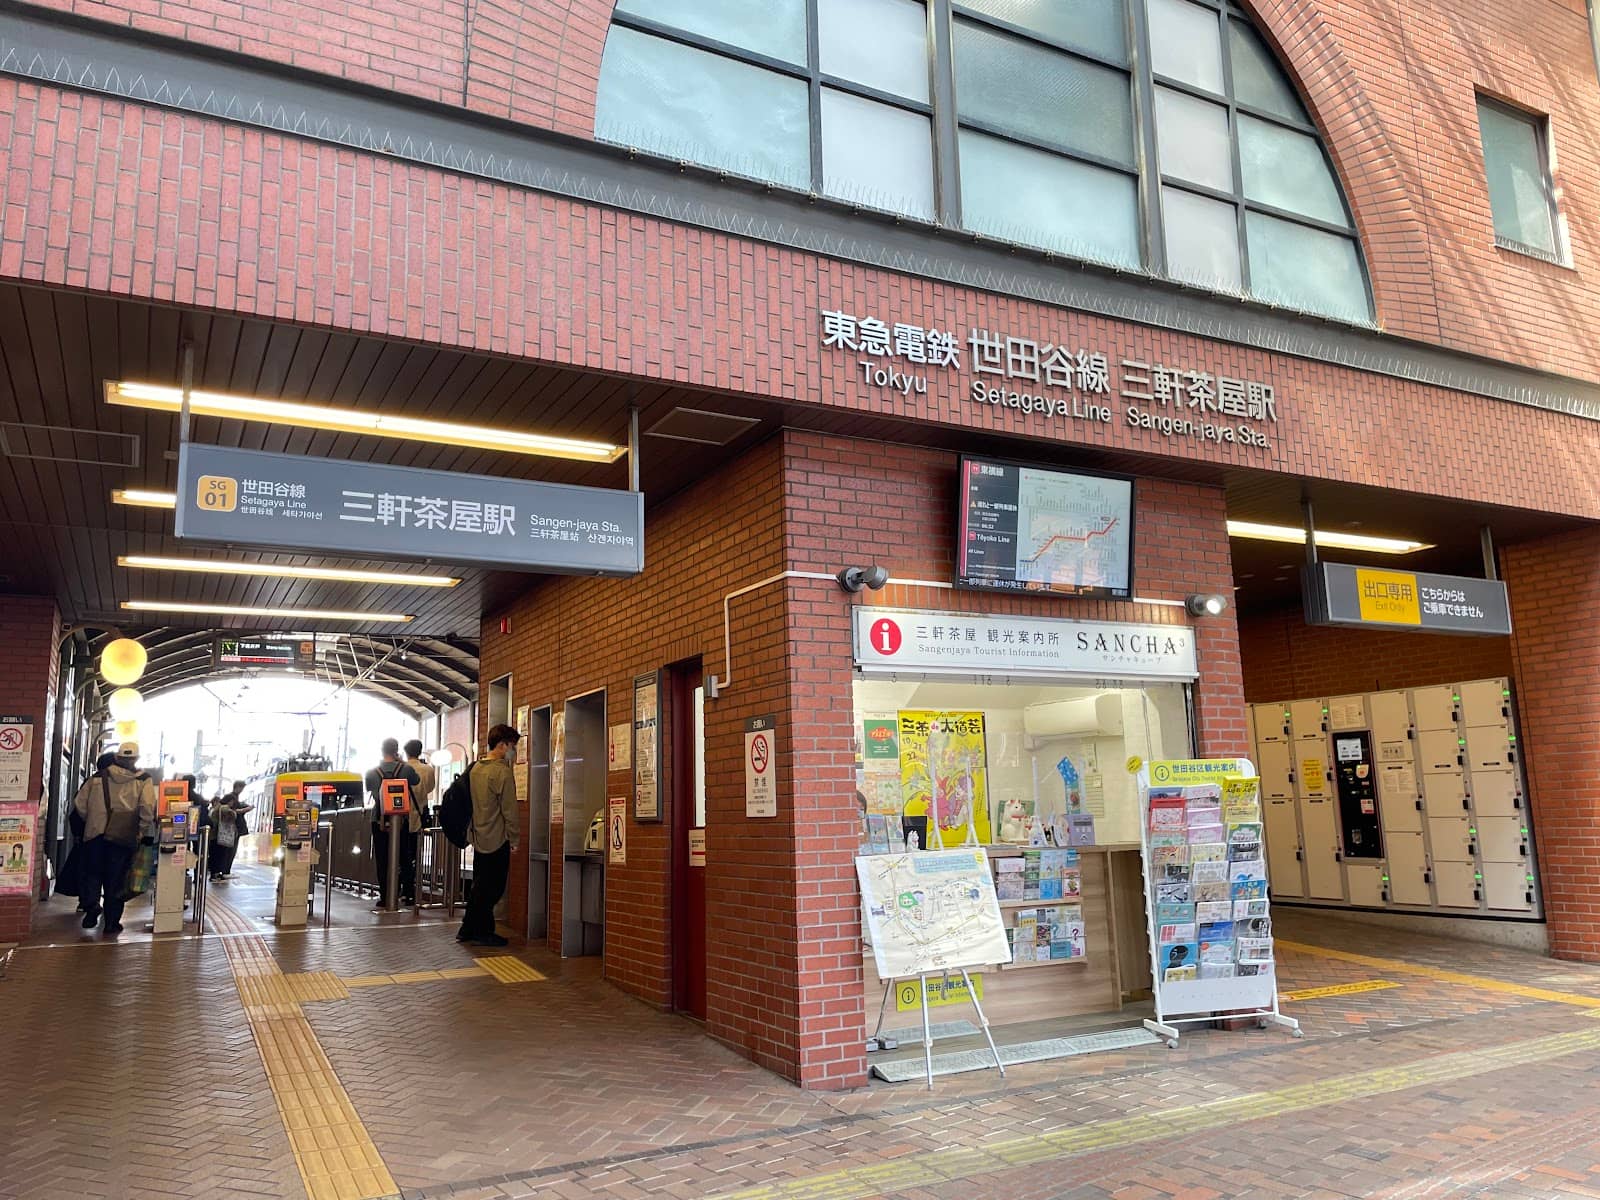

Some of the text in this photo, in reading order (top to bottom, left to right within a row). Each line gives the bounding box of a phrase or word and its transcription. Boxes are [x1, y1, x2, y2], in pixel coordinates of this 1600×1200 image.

[822, 310, 1278, 423] 東急電鉄 世田谷線 三軒茶屋駅
[859, 361, 1273, 449] Tokyu Setagaya Line Sangen-jaya Sta.
[209, 480, 227, 490] SG
[242, 479, 306, 498] 世田谷線
[205, 492, 227, 507] 01
[241, 495, 307, 509] Setagaya Line
[339, 490, 517, 537] 三軒茶屋駅
[530, 514, 623, 533] Sangen-jaya Sta.
[1363, 580, 1413, 602] 出口専用
[1421, 587, 1466, 602] こちらからは
[1423, 602, 1485, 618] ご乗車できません
[916, 626, 1061, 646] 三軒茶屋 観光案内所
[918, 644, 1060, 659] Sangenjaya Tourist Information
